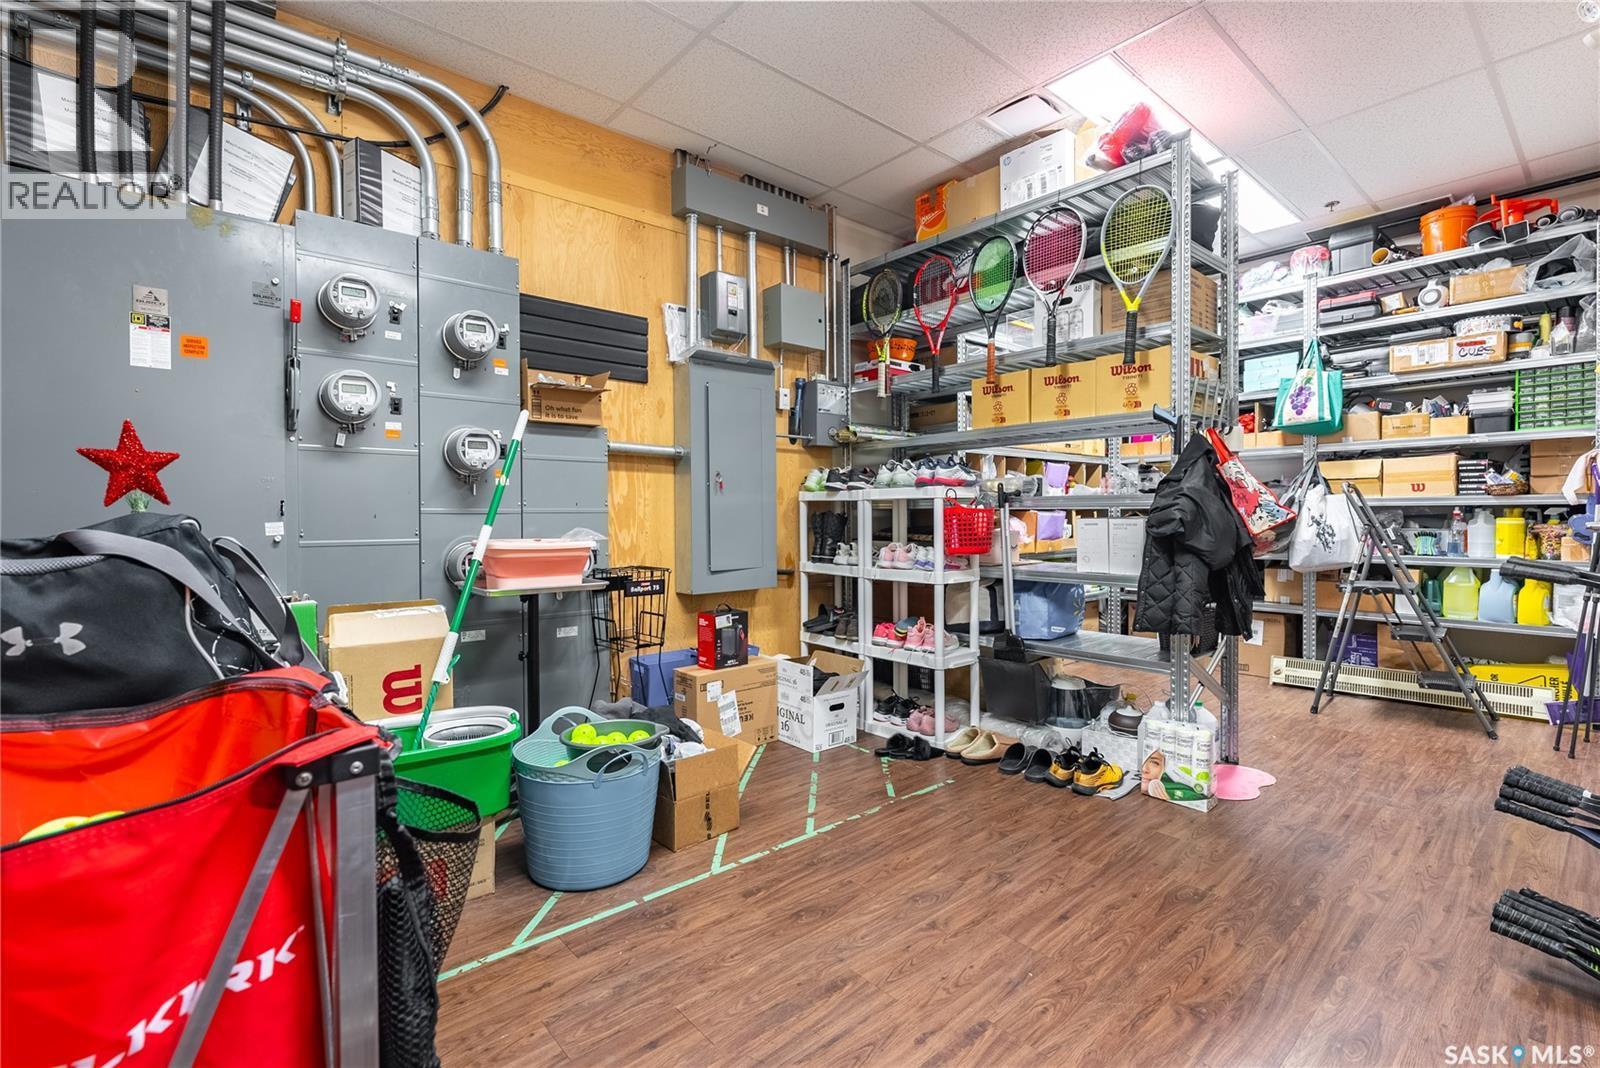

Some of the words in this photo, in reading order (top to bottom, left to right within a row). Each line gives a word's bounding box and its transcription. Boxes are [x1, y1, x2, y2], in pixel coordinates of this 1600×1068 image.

[1458, 345, 1496, 358] CUES
[1109, 363, 1153, 377] Wilson
[1043, 374, 1081, 387] Wilson
[982, 383, 1014, 396] Wilson
[777, 706, 806, 725] IGINAL
[780, 719, 790, 732] 16
